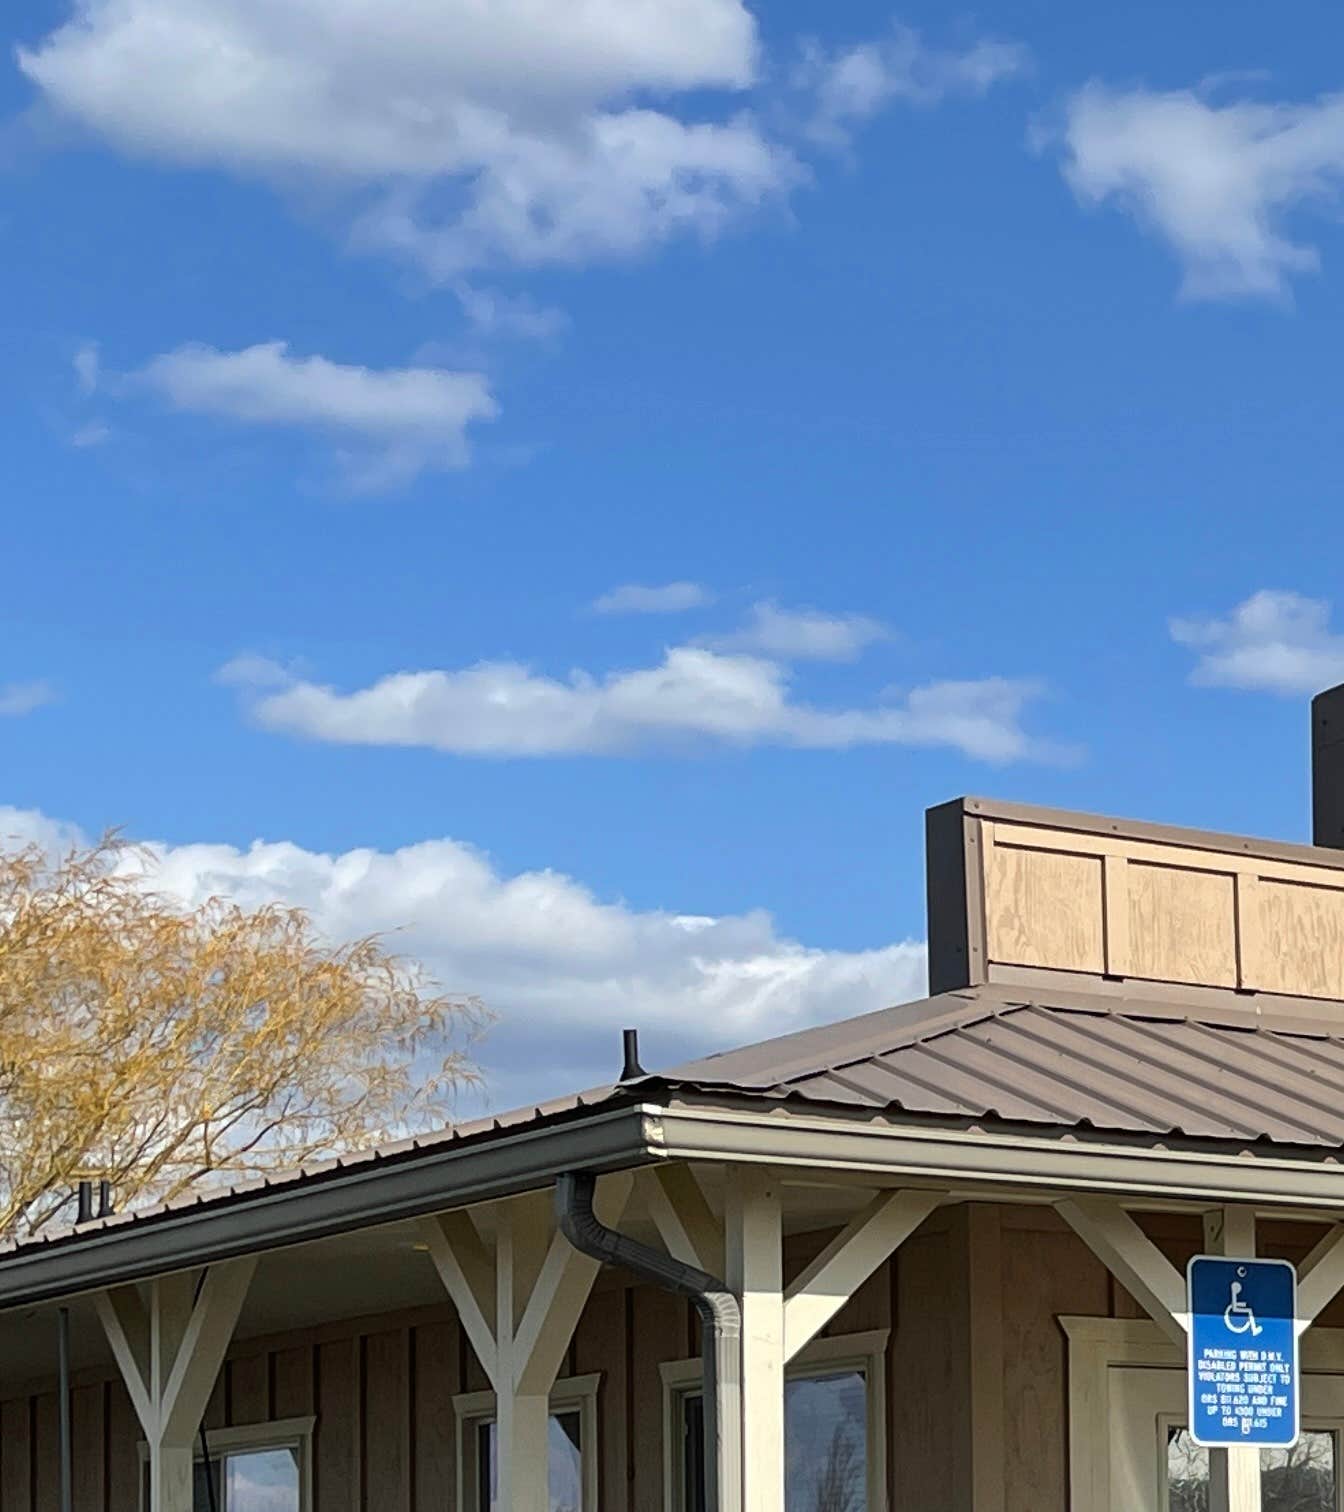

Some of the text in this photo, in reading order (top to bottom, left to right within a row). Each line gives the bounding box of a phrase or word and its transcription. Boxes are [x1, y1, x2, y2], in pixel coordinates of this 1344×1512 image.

[1203, 1348, 1237, 1360] PARKING
[1197, 1359, 1290, 1374] DISABLED PERMIT ONLY
[1198, 1371, 1291, 1385] VIOLATORS SUBJECT TO
[1216, 1382, 1274, 1395] TOWING UNDER
[1252, 1395, 1268, 1405] AND
[1270, 1396, 1288, 1407] FINE
[1206, 1405, 1218, 1416] UP
[1221, 1405, 1232, 1416] TO
[1256, 1407, 1283, 1418] UNDER
